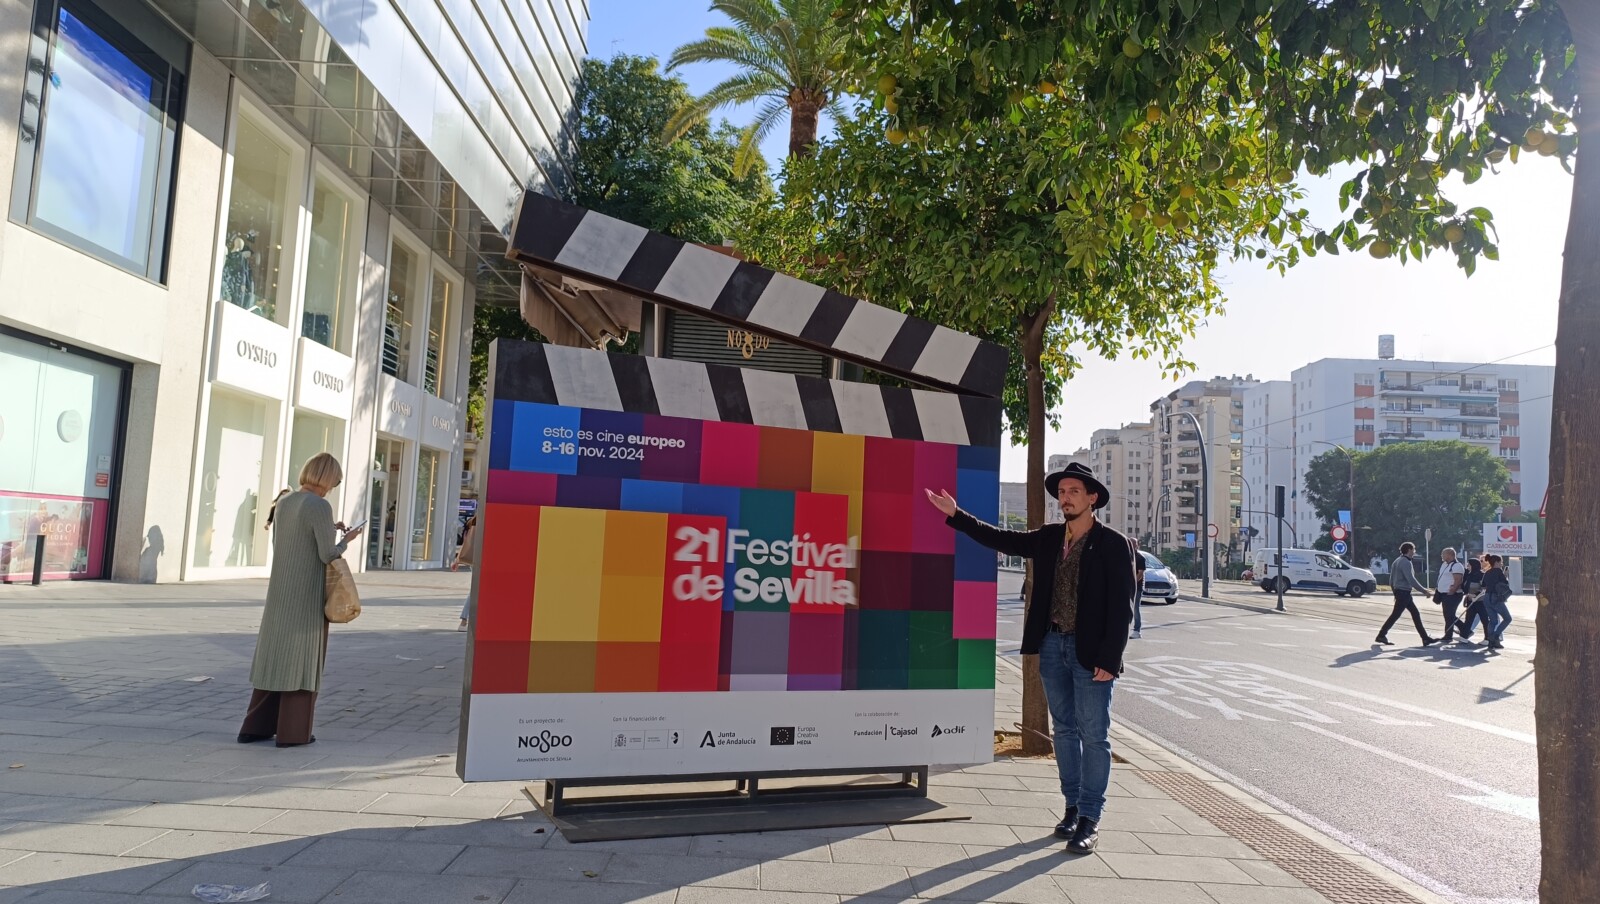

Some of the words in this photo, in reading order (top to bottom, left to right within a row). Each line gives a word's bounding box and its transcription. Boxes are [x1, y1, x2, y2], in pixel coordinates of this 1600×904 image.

[236, 339, 277, 369] OYSHO
[313, 370, 344, 393] OYSHO
[543, 426, 574, 439] esto
[577, 429, 594, 440] es
[596, 429, 625, 443] cine
[627, 434, 686, 450] europeo
[541, 440, 575, 455] 8-16
[578, 446, 606, 458] nov.
[609, 446, 645, 461] 2024
[673, 526, 720, 563] 21
[726, 528, 859, 569] Festival
[672, 566, 725, 602] de
[733, 567, 858, 606] Sevilla
[797, 725, 816, 733] Europa
[890, 726, 918, 738] Cajasol
[943, 725, 966, 735] adif
[726, 737, 756, 746] Andalucía
